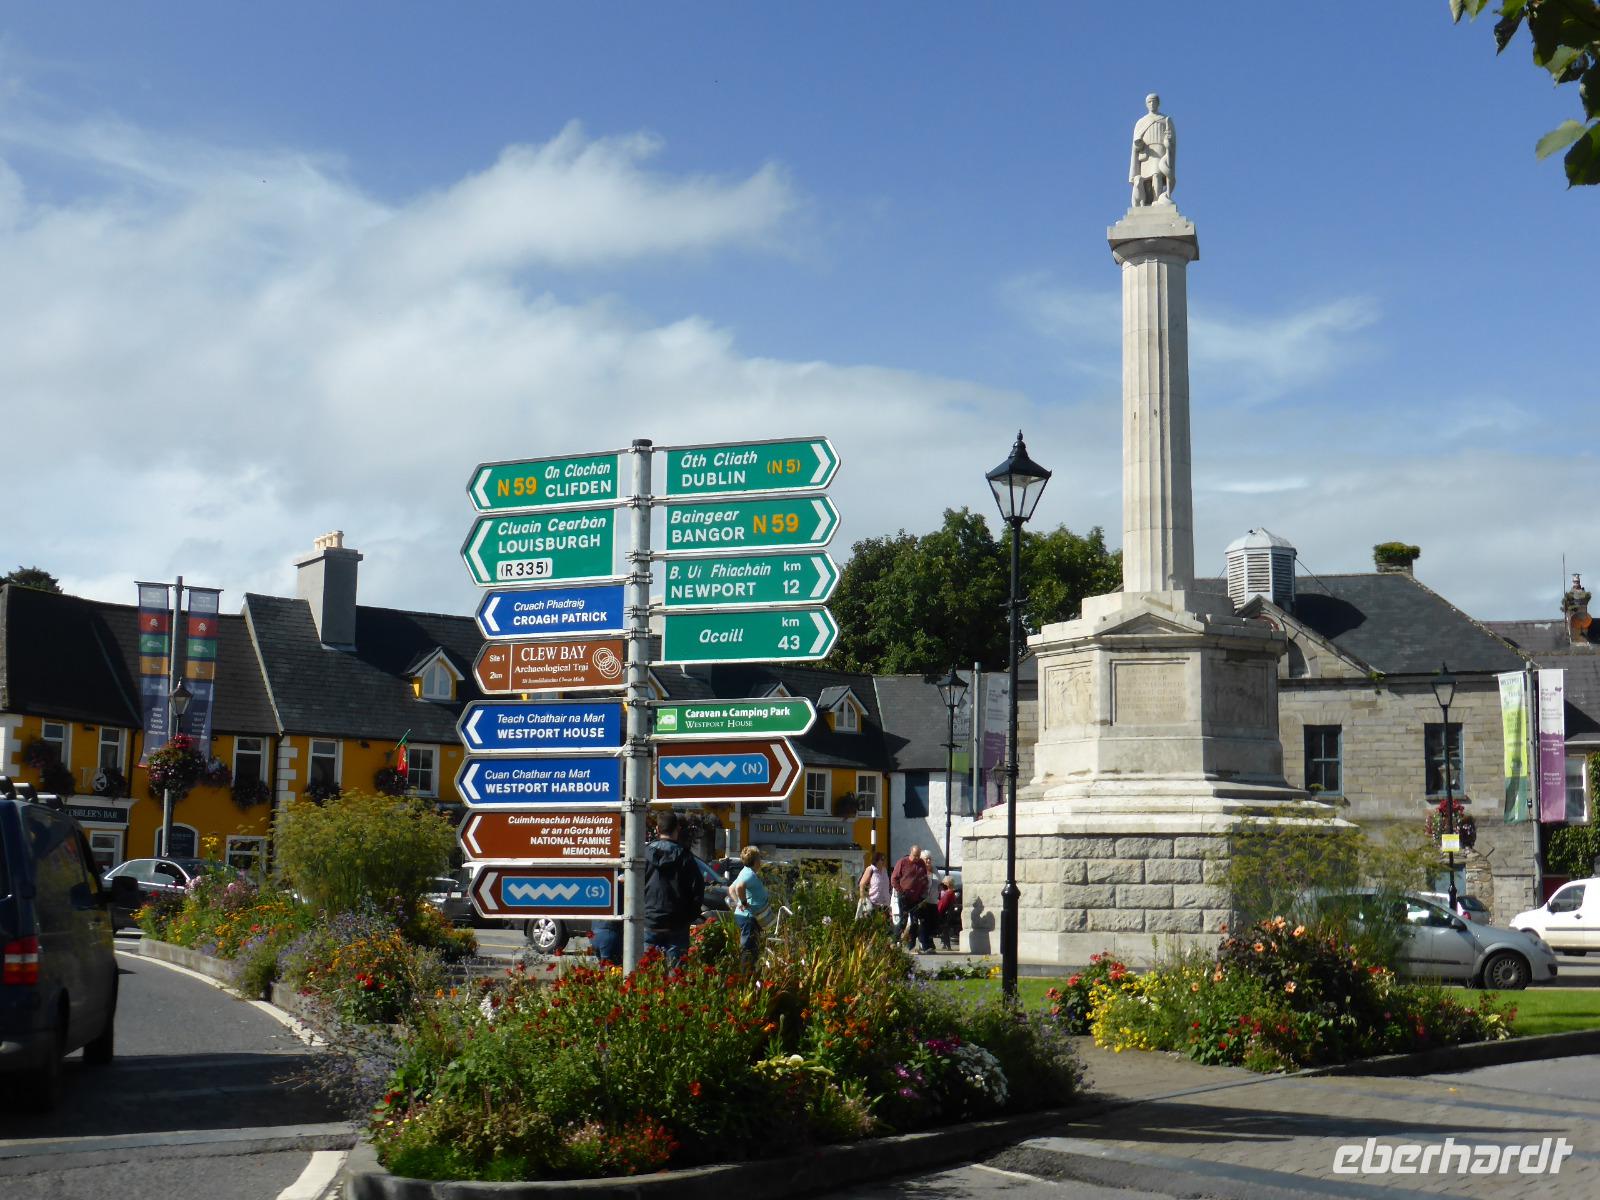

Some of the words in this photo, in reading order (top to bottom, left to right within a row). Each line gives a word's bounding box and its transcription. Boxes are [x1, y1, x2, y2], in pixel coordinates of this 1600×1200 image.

[681, 451, 707, 469] Áth
[713, 450, 758, 467] Cliath
[545, 466, 560, 480] An
[564, 463, 611, 478] Clochán
[682, 470, 746, 487] DUBLIN
[498, 479, 510, 497] N
[514, 476, 537, 496] 59
[545, 479, 612, 498] CLIFDEN
[670, 509, 740, 525] Baingear
[753, 515, 767, 534] N
[771, 513, 799, 533] 59
[498, 520, 542, 535] Cluain
[547, 515, 607, 532] Cearbán
[672, 527, 745, 543] BANGOR
[499, 533, 601, 554] LOUISBURGH
[783, 560, 801, 572] km
[671, 582, 757, 599] NEWPORT
[783, 579, 800, 594] 12
[513, 601, 545, 612] Cruach
[513, 615, 559, 626] CROAGH
[561, 611, 608, 623] PATRICK
[781, 616, 800, 627] km
[699, 628, 744, 644] Acaill
[778, 635, 801, 651] 43
[489, 654, 501, 662] Site
[520, 646, 558, 662] CLEW
[560, 645, 587, 660] BAY
[514, 662, 571, 674] Archaeological
[496, 713, 525, 724] Teach
[527, 712, 567, 724] Chathair
[568, 715, 581, 723] na
[583, 712, 606, 723] Mart
[685, 708, 721, 718] Caravan
[728, 707, 769, 719] Camping
[770, 706, 791, 716] Park
[497, 728, 561, 739] WESTPORT
[563, 727, 605, 738] HOUSE
[484, 769, 510, 780] Cuan
[512, 769, 552, 779] Chathair
[554, 770, 566, 779] na
[568, 768, 590, 778] Mart
[742, 761, 763, 775] (N)
[485, 782, 549, 794] WESTPORT
[551, 781, 610, 793] HARBOUR
[508, 815, 571, 824] Cuimhneachán
[572, 815, 613, 824] Náisiúnta
[540, 827, 550, 835] ar
[551, 827, 562, 835] an
[564, 825, 594, 835] nGorta
[595, 825, 613, 835] Mór
[530, 836, 575, 845] NATIONAL
[577, 836, 611, 845] FAMINE
[562, 847, 611, 856] MEMORIAL
[585, 884, 605, 898] (S)
